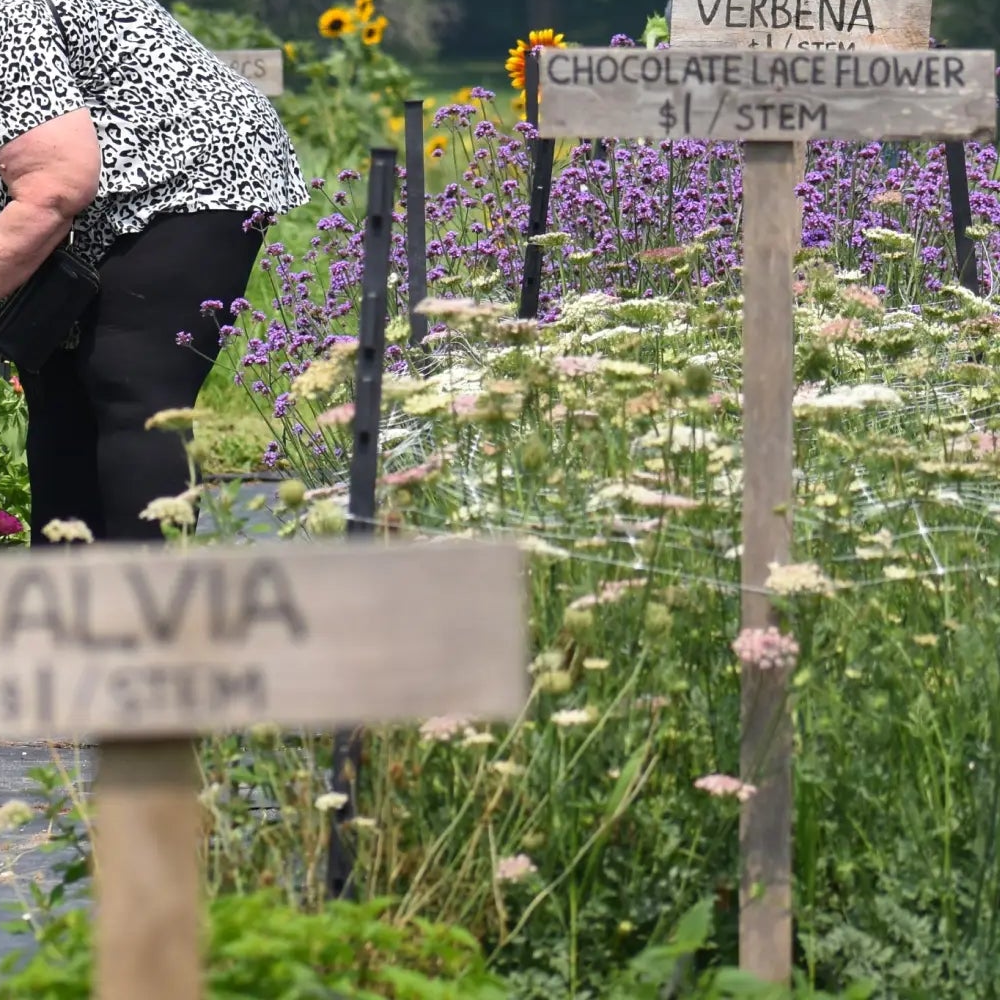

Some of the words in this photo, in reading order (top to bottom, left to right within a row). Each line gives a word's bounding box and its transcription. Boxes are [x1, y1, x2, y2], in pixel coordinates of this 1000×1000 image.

[547, 53, 742, 87] CHOCOLATE
[750, 53, 826, 87] LACE
[835, 53, 966, 88] FLOWER
